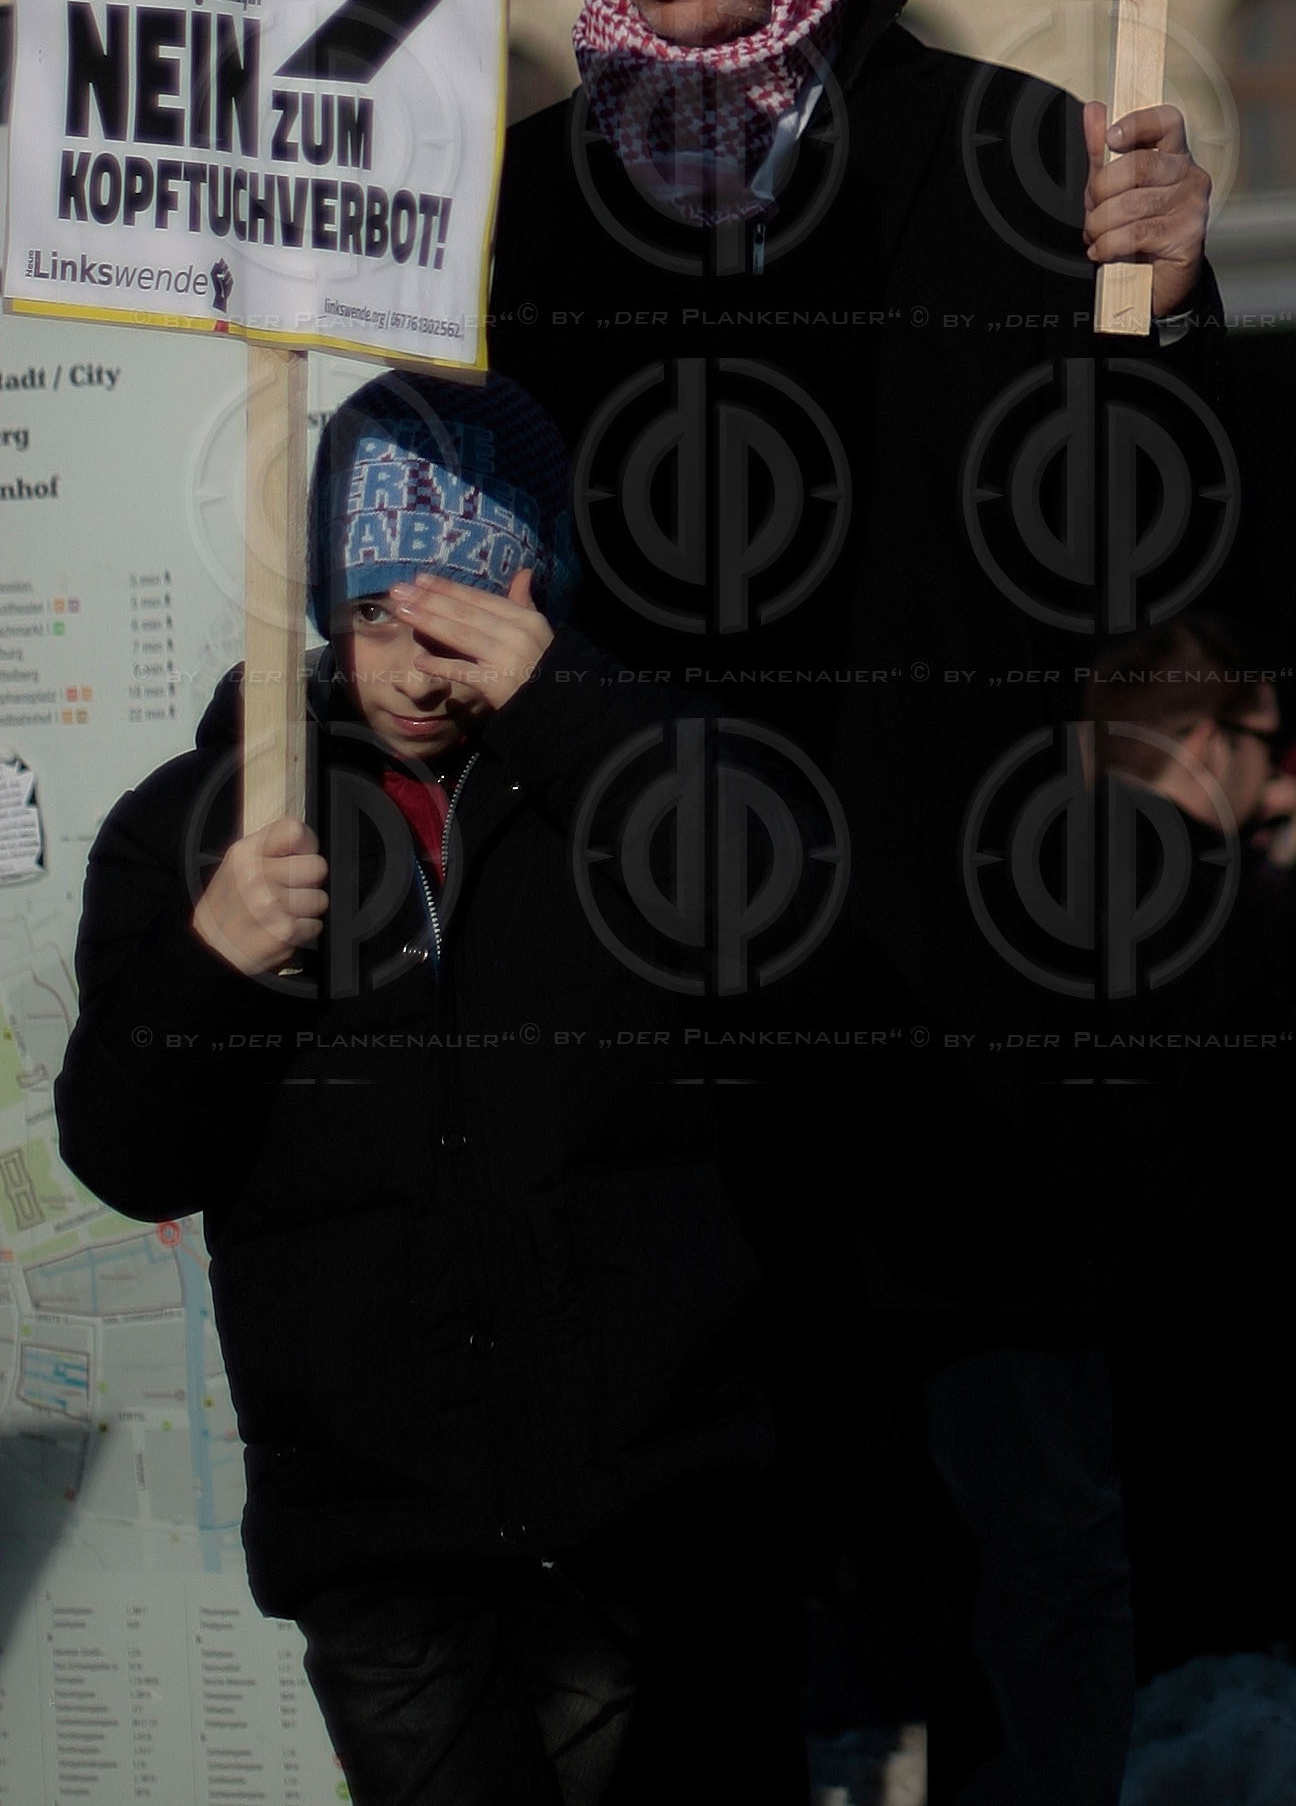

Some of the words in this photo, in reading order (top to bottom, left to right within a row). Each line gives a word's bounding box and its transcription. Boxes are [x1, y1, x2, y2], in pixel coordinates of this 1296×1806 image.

[65, 0, 261, 158] NEIN
[271, 90, 374, 171] ZUM
[57, 150, 452, 271] KOPFTUCHVERBOT!
[34, 250, 208, 294] Linkswende
[69, 364, 121, 392] City
